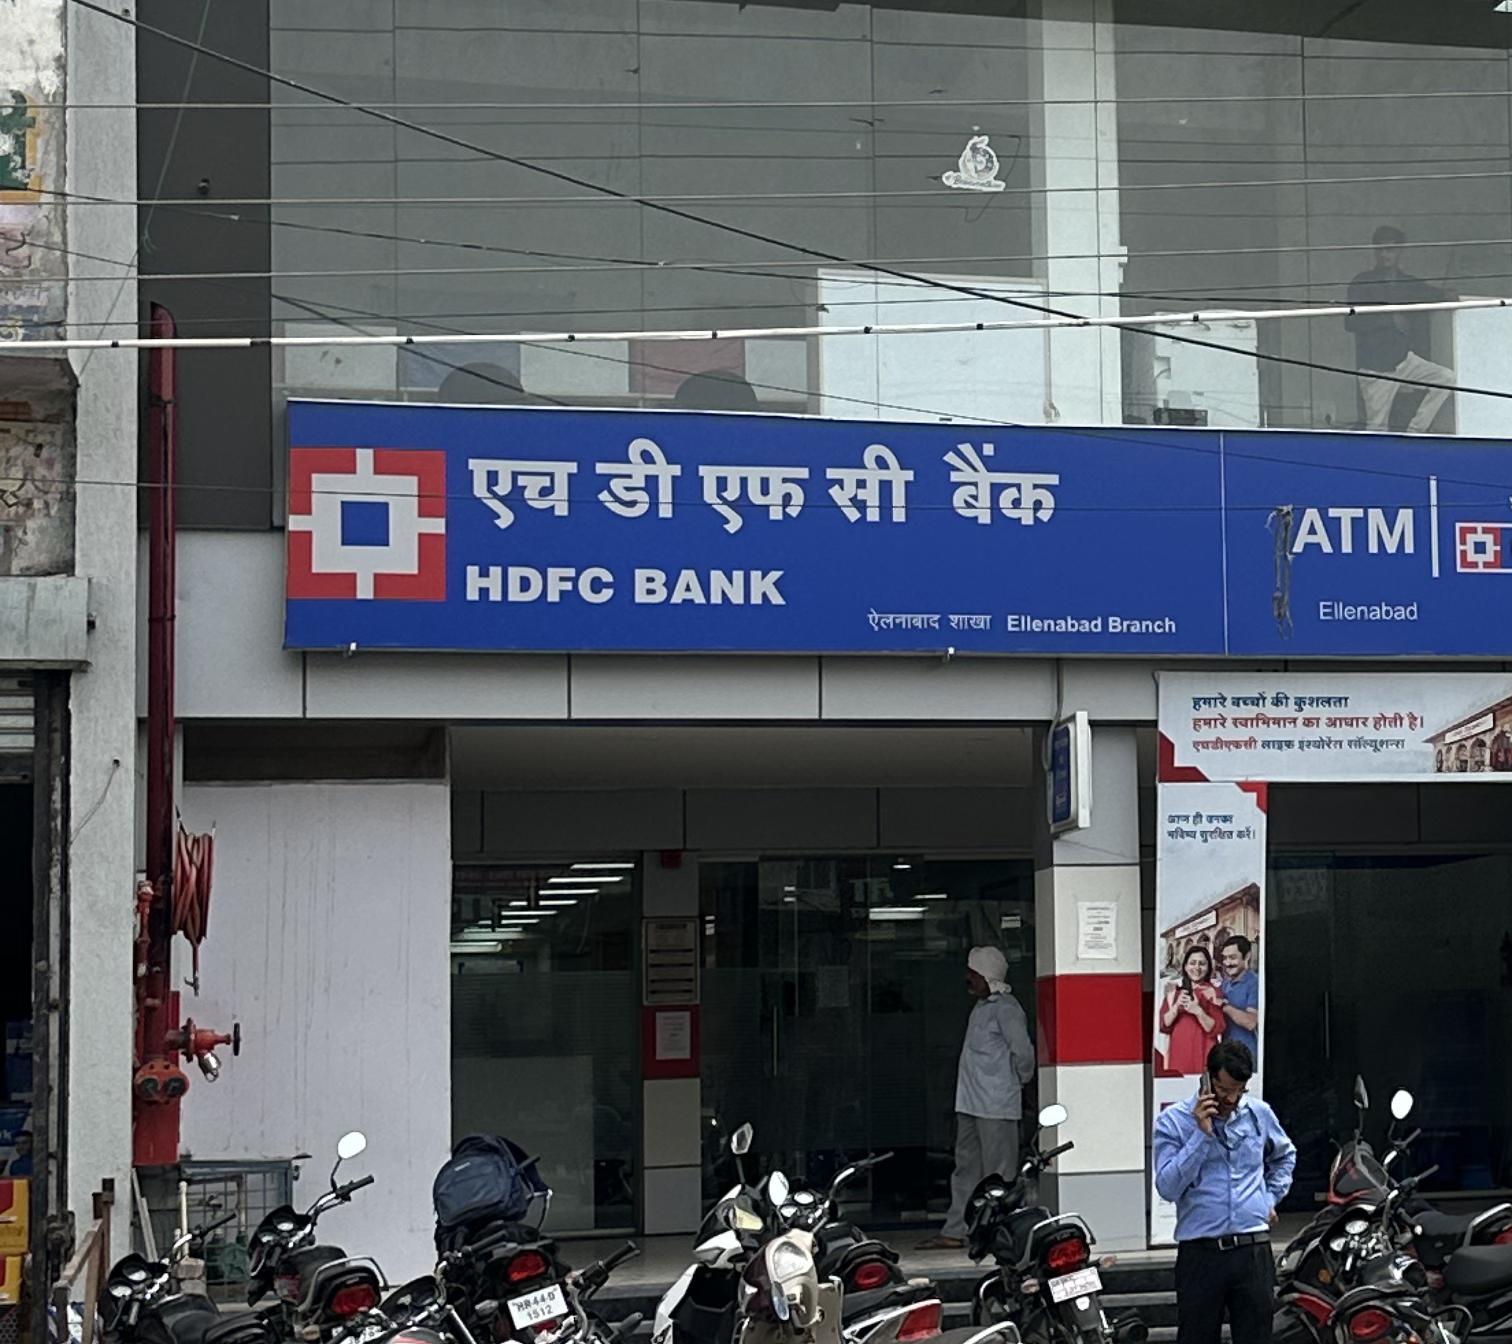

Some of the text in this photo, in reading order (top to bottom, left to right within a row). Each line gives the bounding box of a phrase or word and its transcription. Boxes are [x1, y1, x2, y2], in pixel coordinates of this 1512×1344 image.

[469, 438, 1059, 534] एच डी एफ सी बैंक
[1292, 508, 1415, 555] ATM
[466, 565, 787, 606] HDFC BANK
[868, 607, 1176, 634] ऐलनाबाद शाखा Ellenabad Branch
[1319, 600, 1419, 622] Ellenabad
[1192, 692, 1228, 711] हमारे
[1271, 692, 1289, 708] की
[1294, 695, 1350, 713] कुशलता
[1192, 713, 1228, 732] हमारे
[1231, 713, 1298, 729] स्वाभिमान
[1302, 716, 1321, 729] का
[1325, 716, 1368, 729] आधार
[1373, 712, 1404, 731] होती
